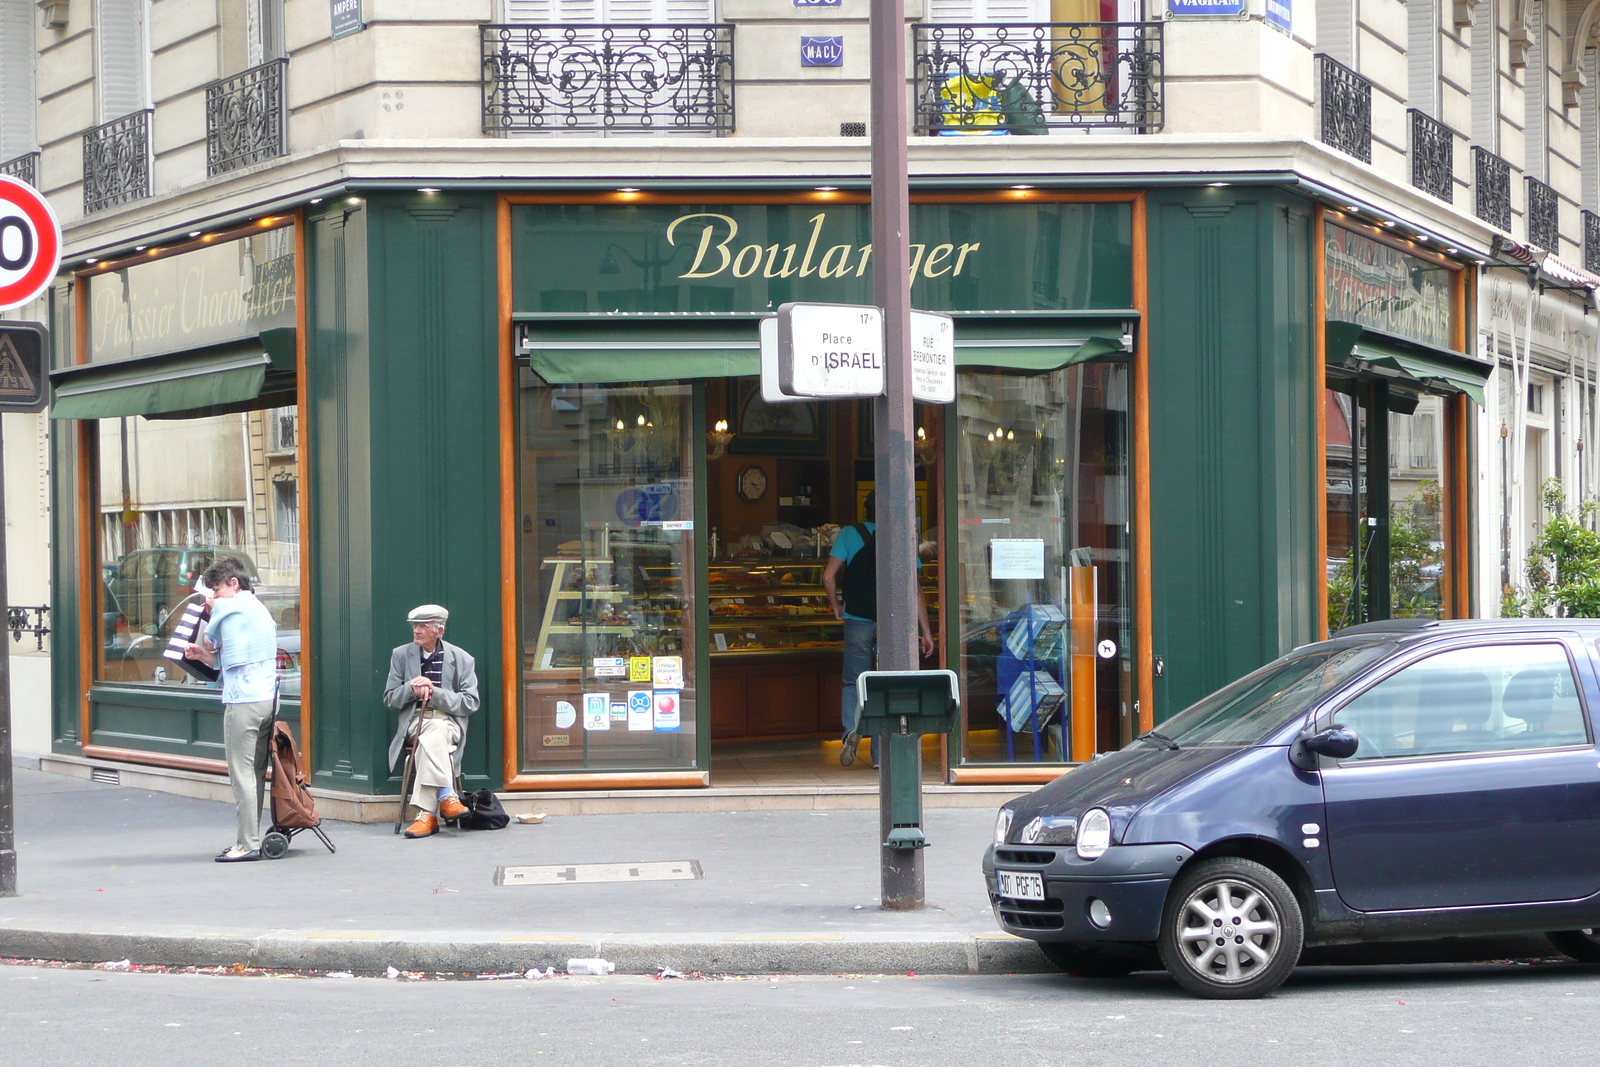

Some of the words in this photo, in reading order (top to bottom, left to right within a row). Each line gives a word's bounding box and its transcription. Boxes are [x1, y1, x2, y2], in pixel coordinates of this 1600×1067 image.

[181, 264, 293, 335] Chocolatier
[822, 333, 853, 345] Place
[923, 336, 934, 349] RUE
